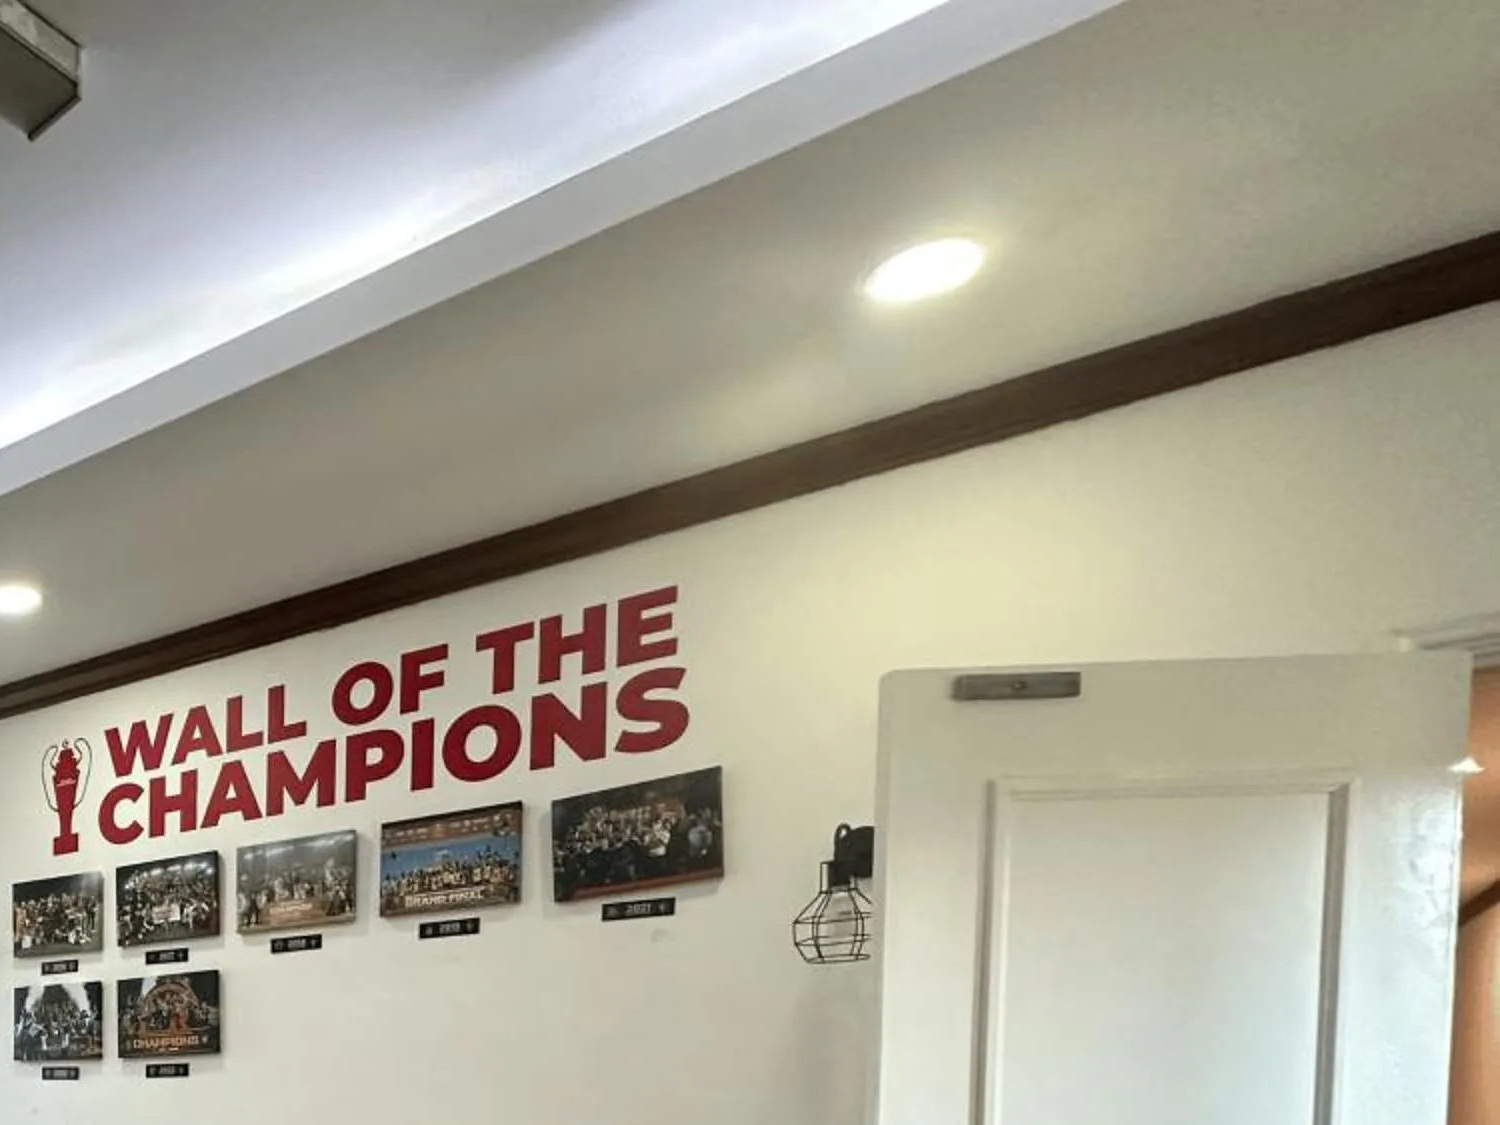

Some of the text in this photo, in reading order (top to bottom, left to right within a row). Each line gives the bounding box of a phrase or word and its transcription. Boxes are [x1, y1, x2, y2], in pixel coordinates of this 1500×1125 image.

[98, 667, 690, 844] CHAMPIONS
[105, 586, 678, 777] WALL OF THE
[133, 1035, 199, 1049] CHAMPIONS
